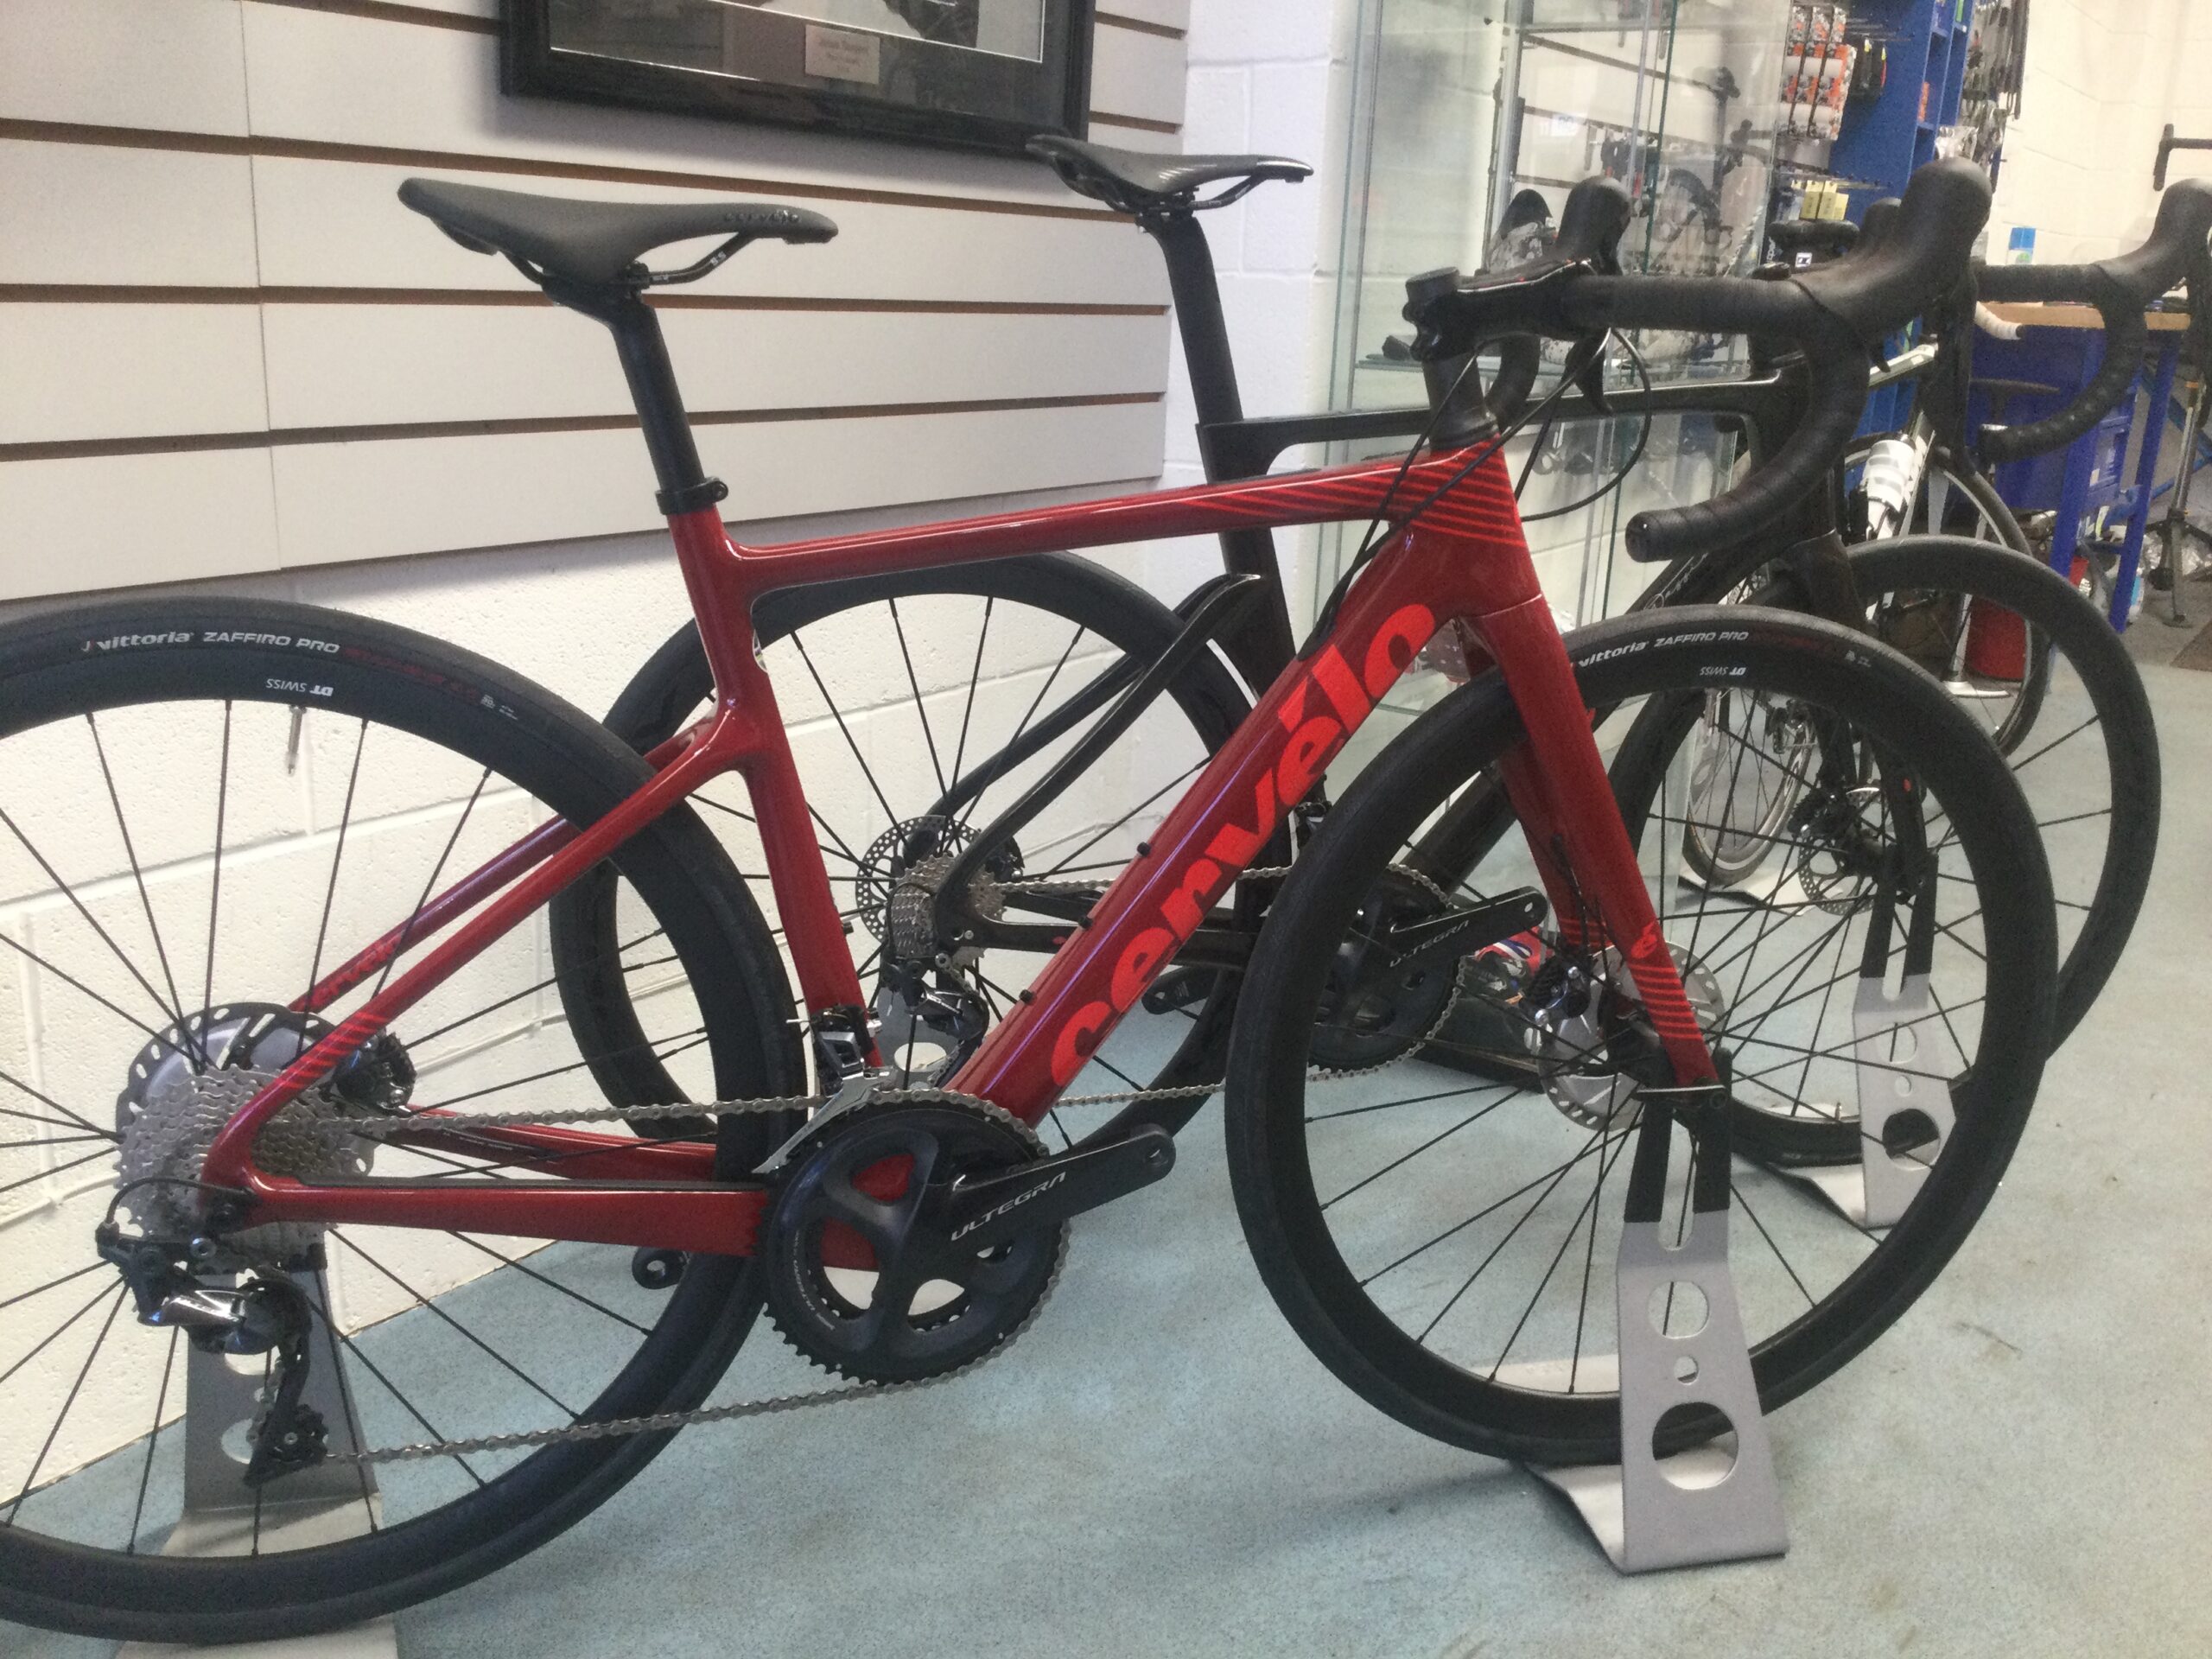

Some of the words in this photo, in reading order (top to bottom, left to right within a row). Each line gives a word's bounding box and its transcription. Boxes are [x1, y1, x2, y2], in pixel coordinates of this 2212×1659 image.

[96, 632, 193, 651] vittoria
[203, 632, 291, 646] ZAFFIRO
[295, 638, 340, 654] PRO
[1578, 640, 1649, 668] vittoria
[1653, 632, 1716, 648] ZAFFIRO
[1718, 631, 1750, 642] PRO
[1699, 665, 1729, 677] SWISS
[1729, 665, 1747, 677] DT
[265, 677, 308, 693] SWISS
[308, 684, 334, 698] DT
[951, 1171, 1066, 1242] ULTEGRA
